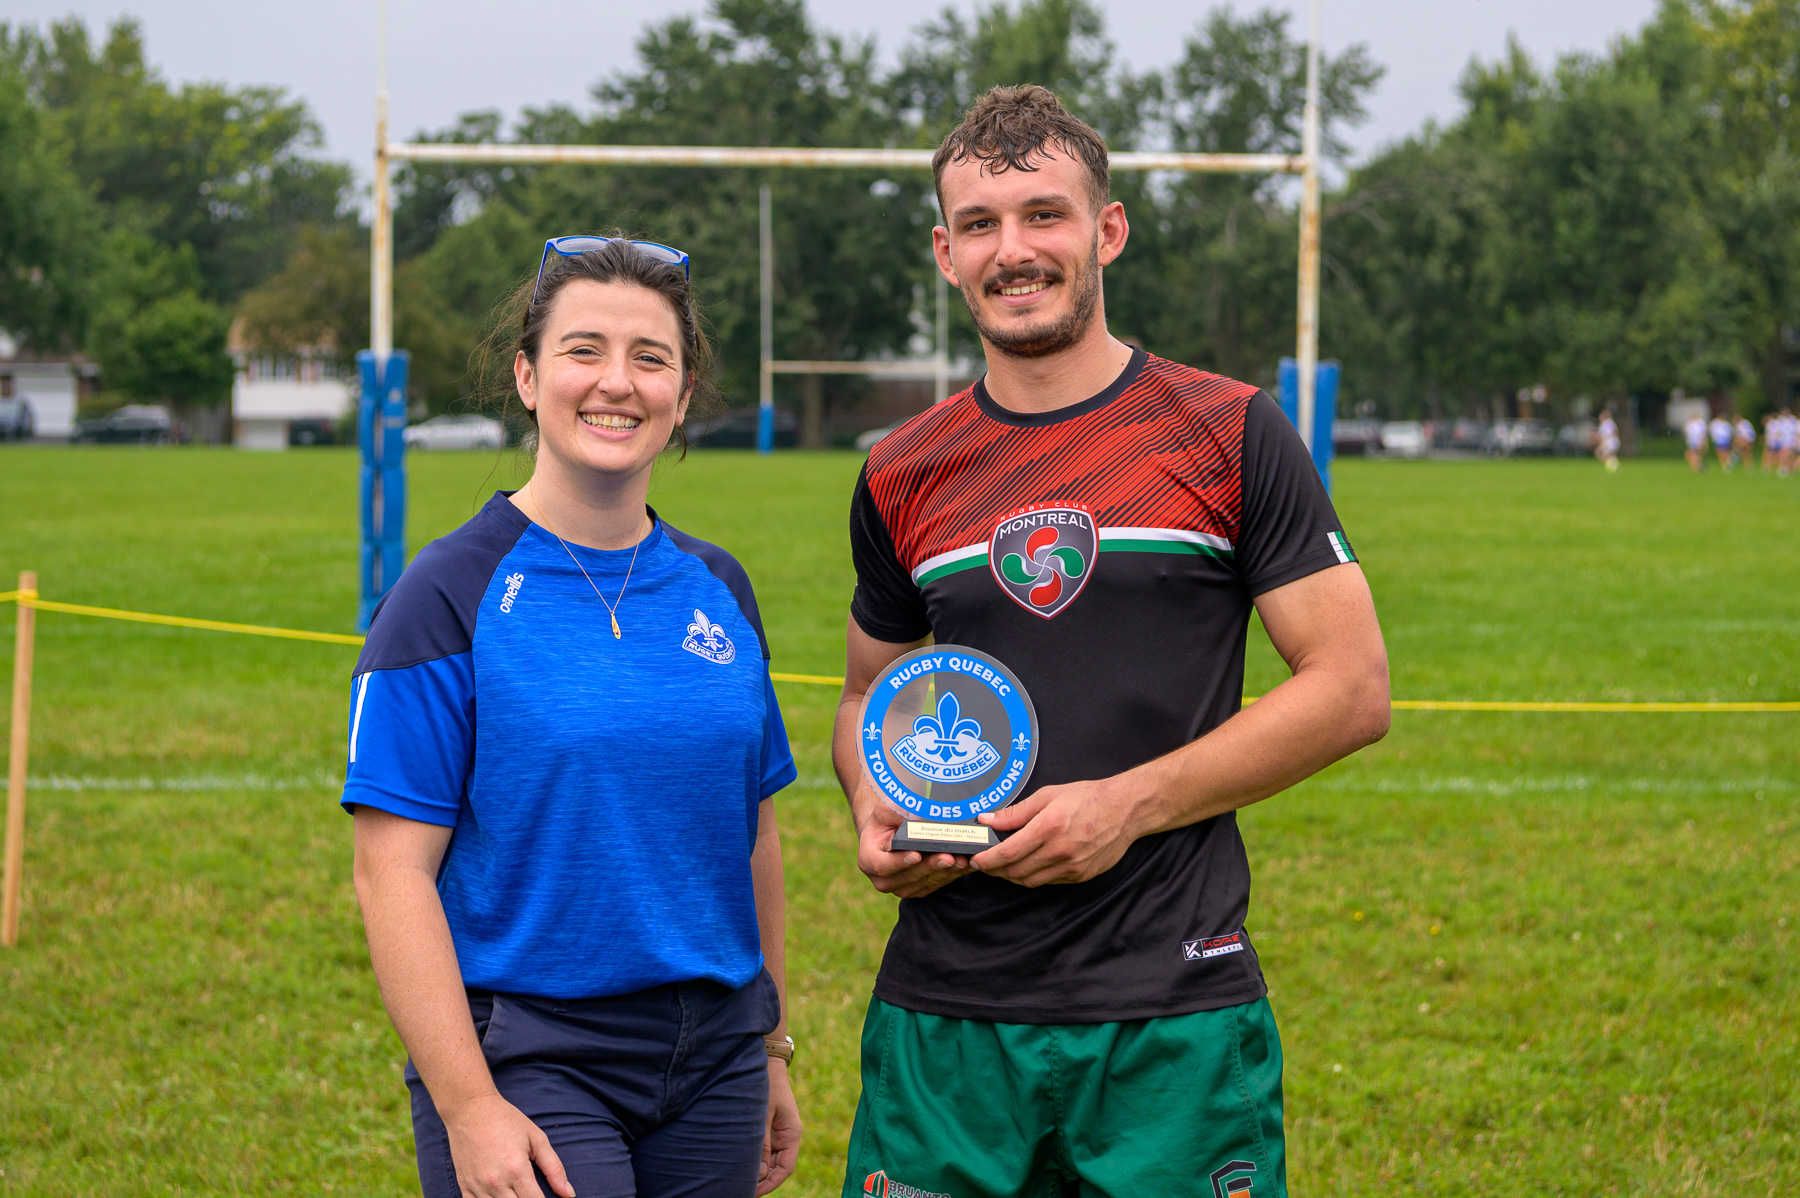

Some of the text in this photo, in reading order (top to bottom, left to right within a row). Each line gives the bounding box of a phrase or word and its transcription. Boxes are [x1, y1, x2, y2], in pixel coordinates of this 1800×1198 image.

[1000, 502, 1088, 521] RUGBY CLUB
[1000, 513, 1088, 540] MONTREAL
[889, 656, 1011, 697] RUGBY QUEBEC
[899, 746, 993, 777] RUGBY QUÉBEC
[869, 750, 1025, 818] TOURNOI DES RÉGIONS
